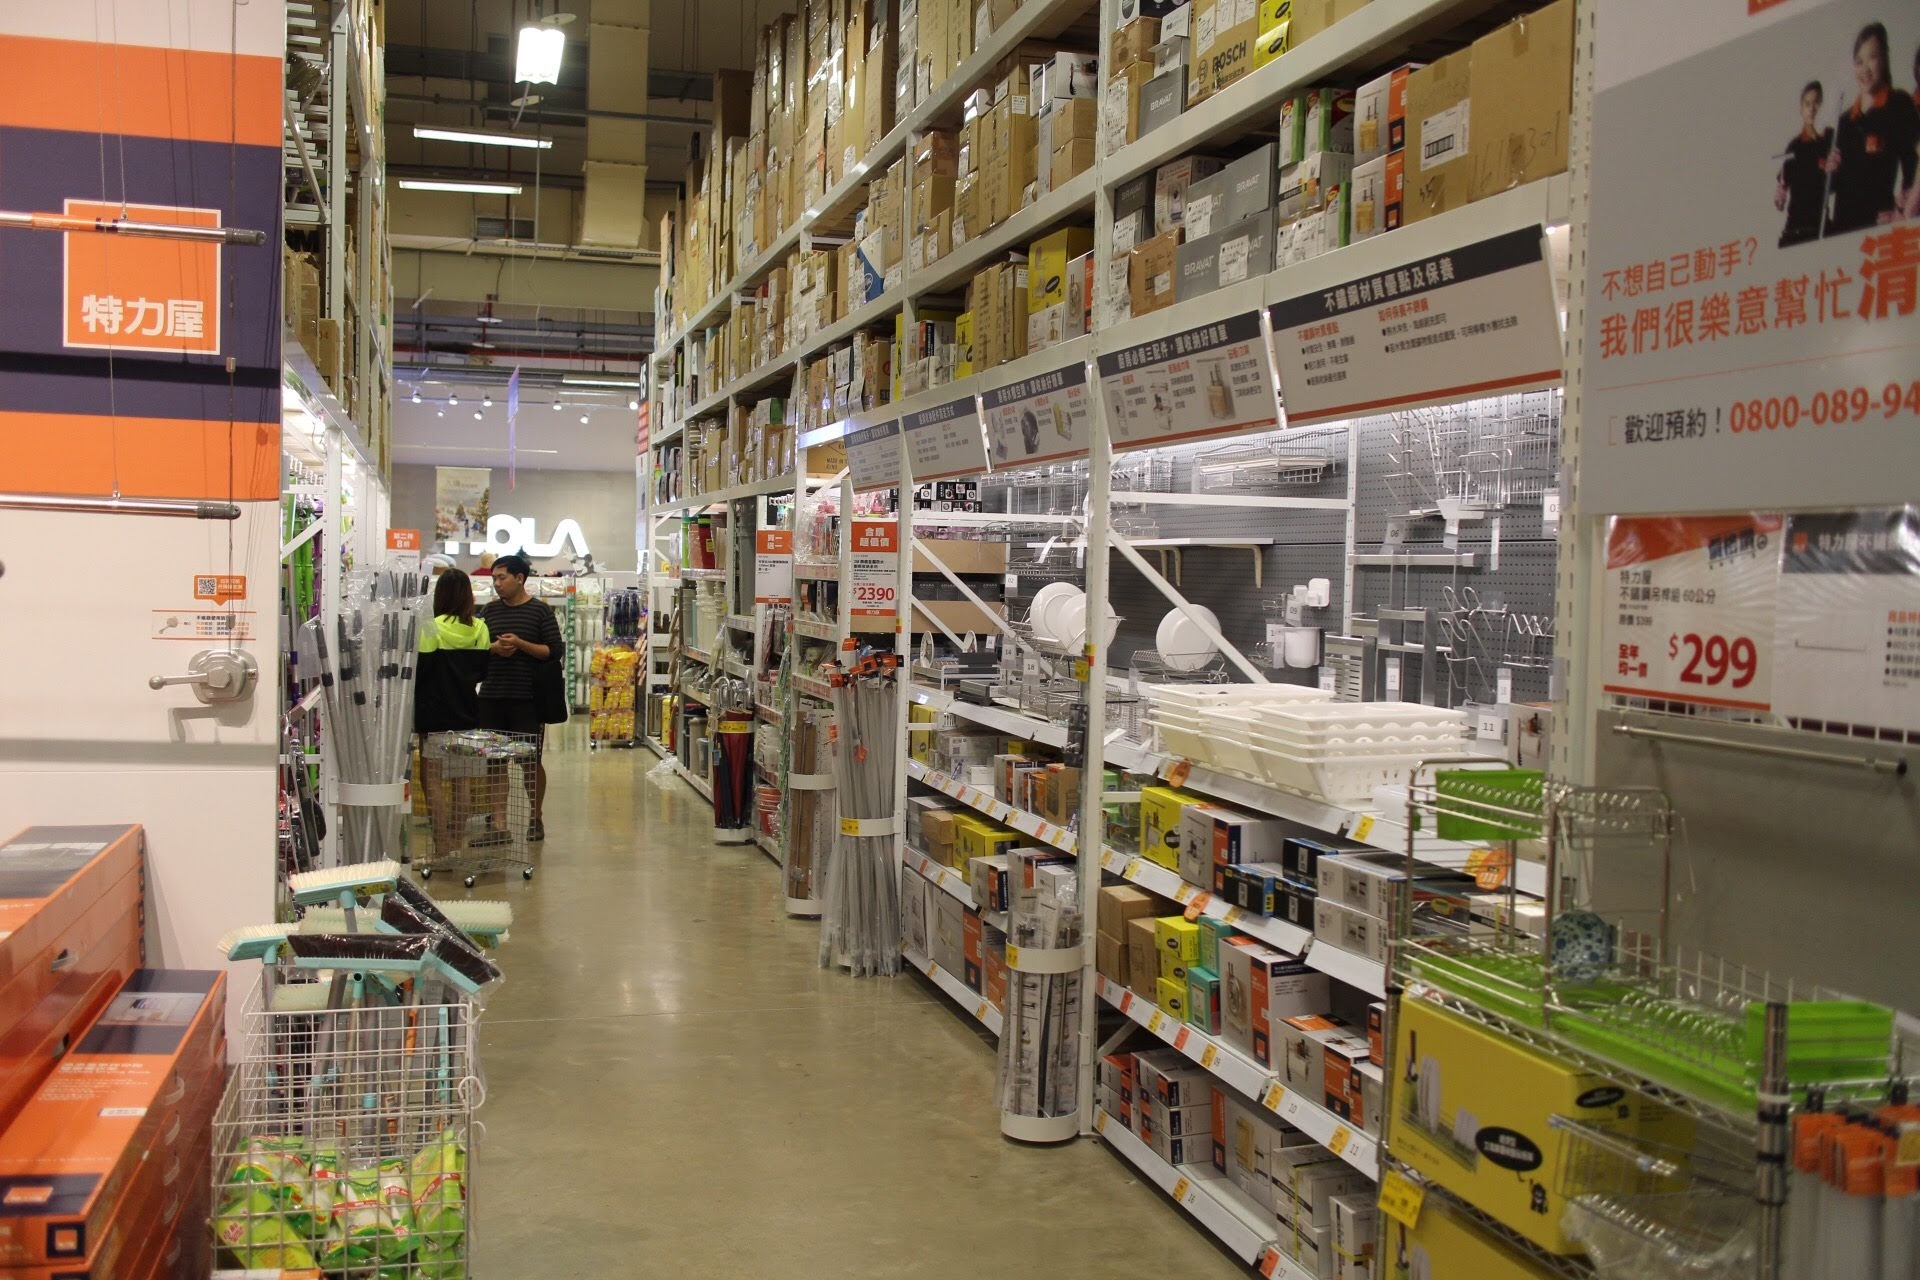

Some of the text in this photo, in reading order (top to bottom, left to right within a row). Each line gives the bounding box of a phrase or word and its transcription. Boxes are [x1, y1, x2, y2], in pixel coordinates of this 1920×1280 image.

[1236, 174, 1260, 193] BRAVAT
[1184, 255, 1215, 276] BRAVAT
[81, 293, 205, 339] 特力屋
[1390, 529, 1400, 538] 06
[1619, 570, 1652, 586] 特力屋
[852, 587, 895, 602] $2390
[1668, 632, 1758, 689] $299
[1483, 722, 1495, 731] 11
[1349, 1143, 1360, 1156] 11
